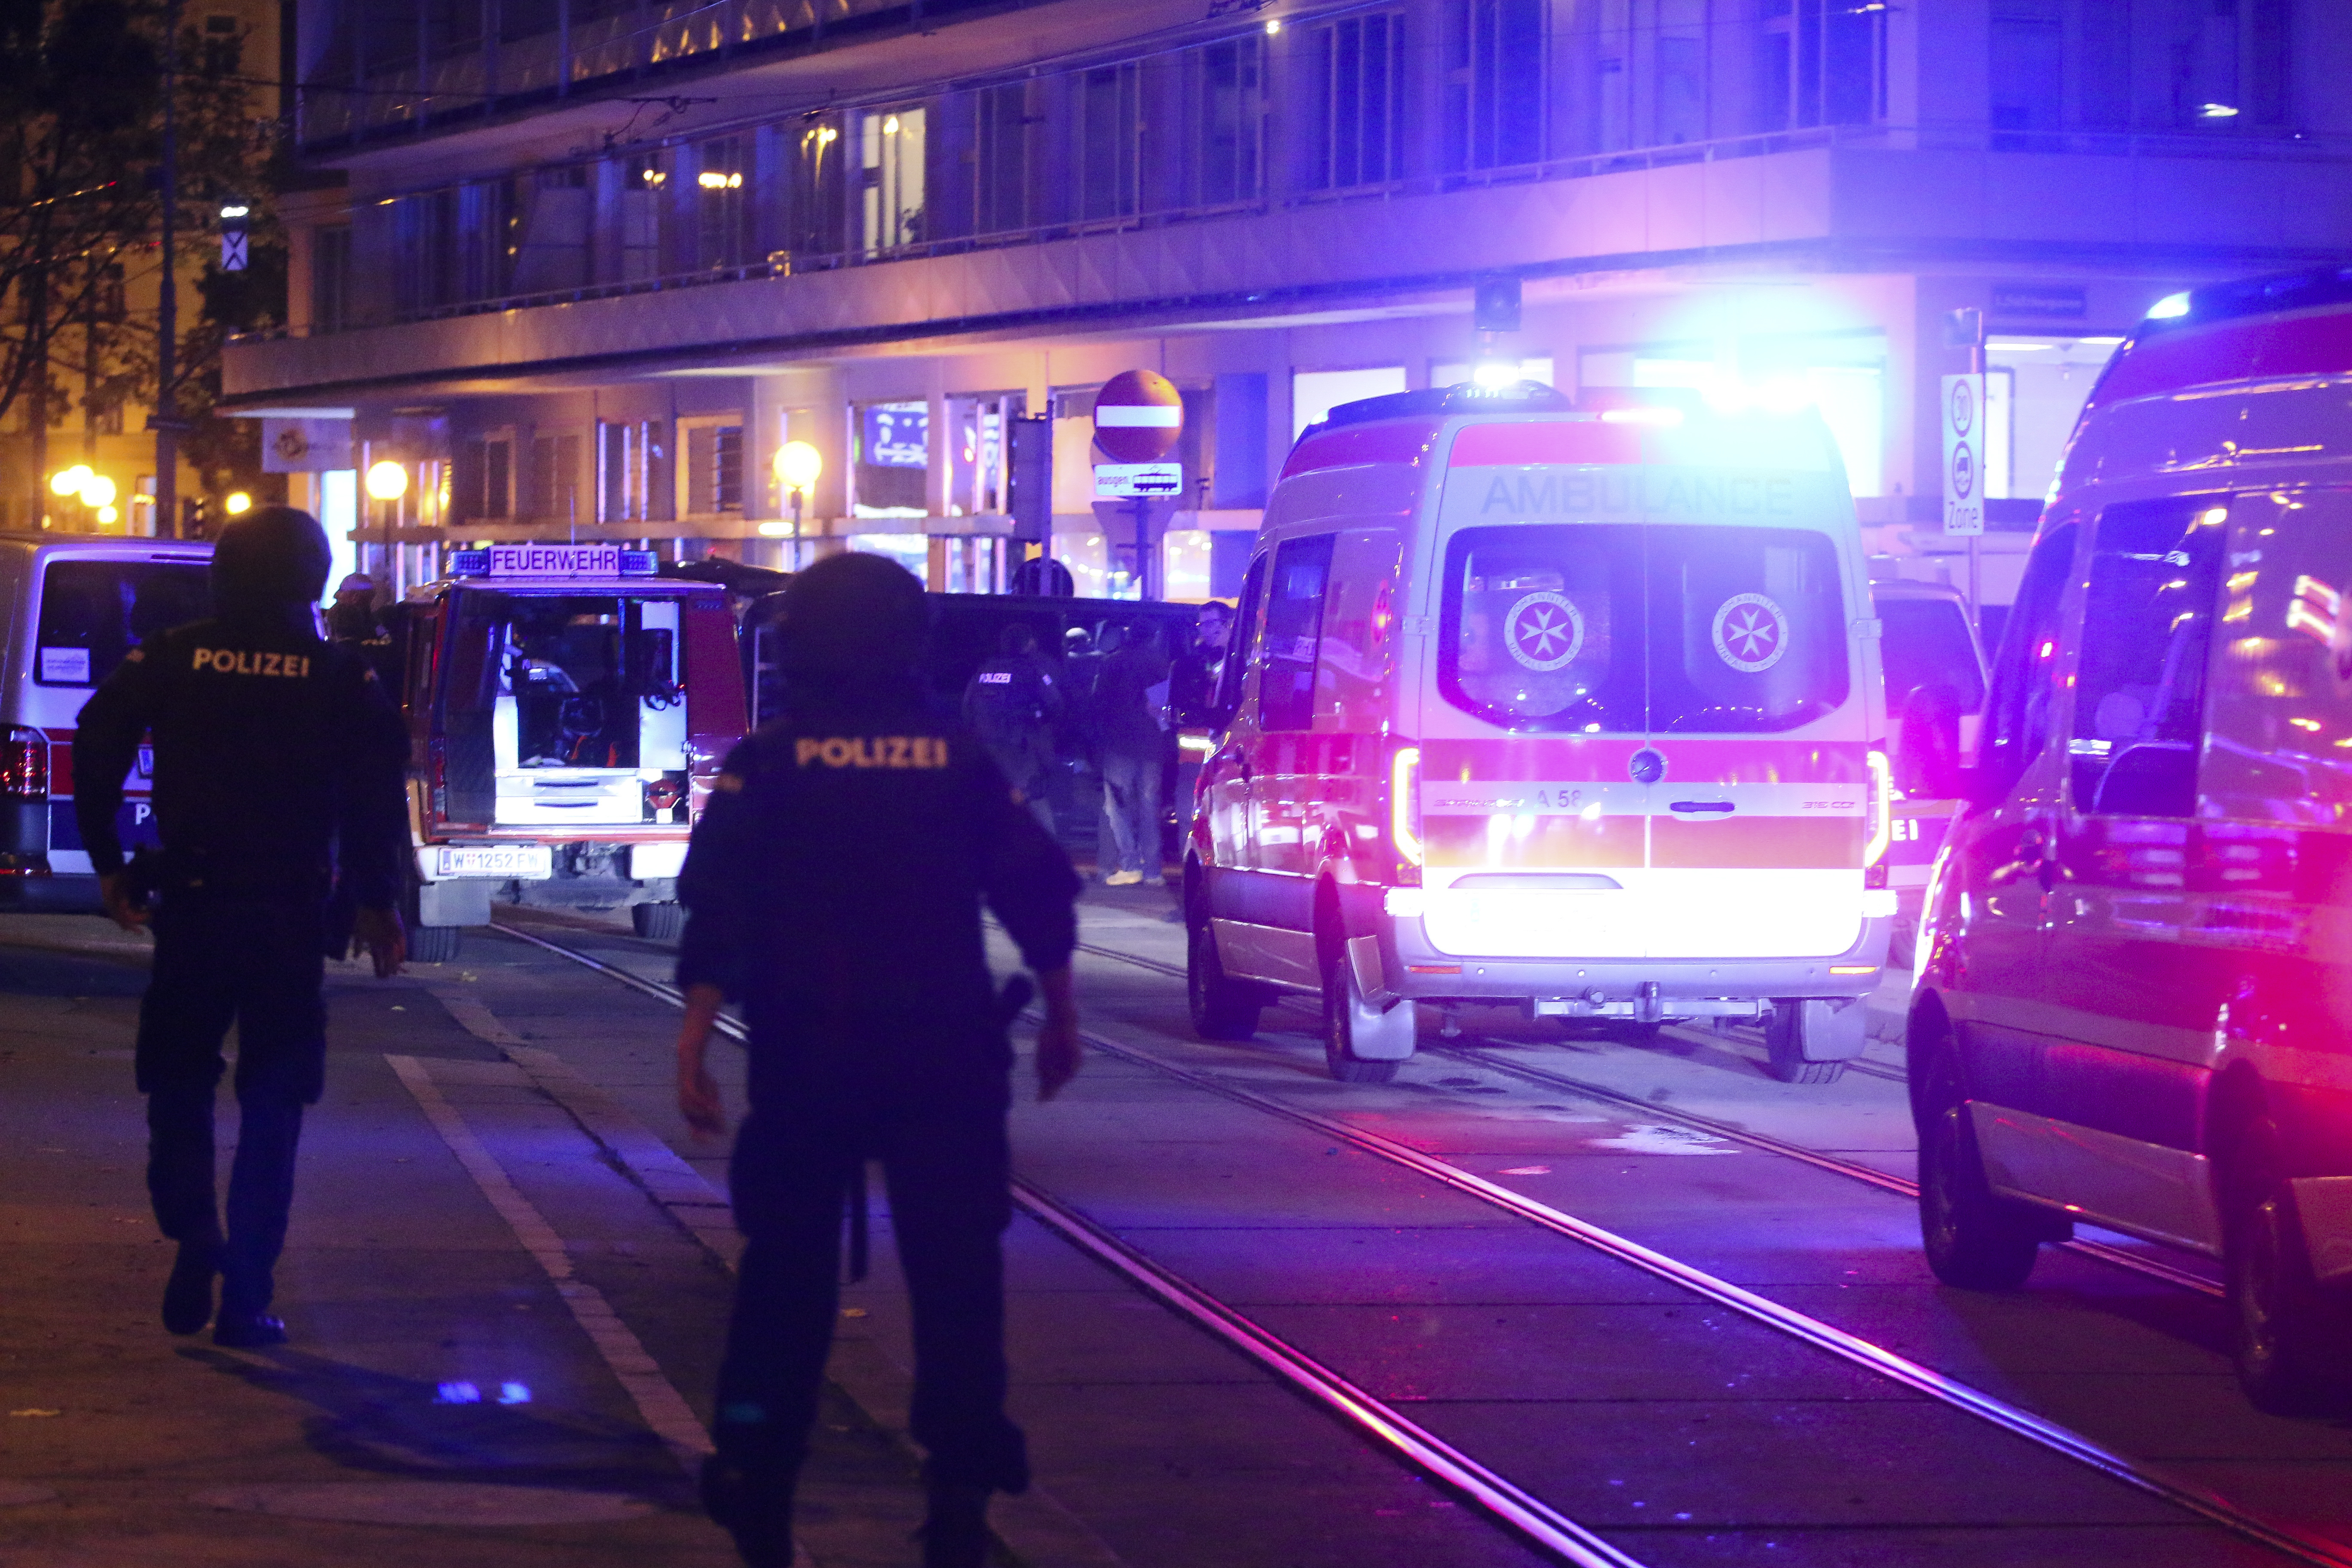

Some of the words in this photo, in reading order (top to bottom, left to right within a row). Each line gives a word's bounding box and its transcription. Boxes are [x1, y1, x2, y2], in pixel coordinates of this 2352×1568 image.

[1480, 475, 1792, 515] AMBULANCE
[1948, 501, 1978, 529] Zone
[494, 551, 615, 569] FEUERWEHR
[193, 648, 309, 677] POLIZEI
[979, 673, 1011, 683] POLIZEI
[796, 737, 947, 768] POLIZEI
[1535, 790, 1551, 807] A
[478, 853, 513, 868] 1252
